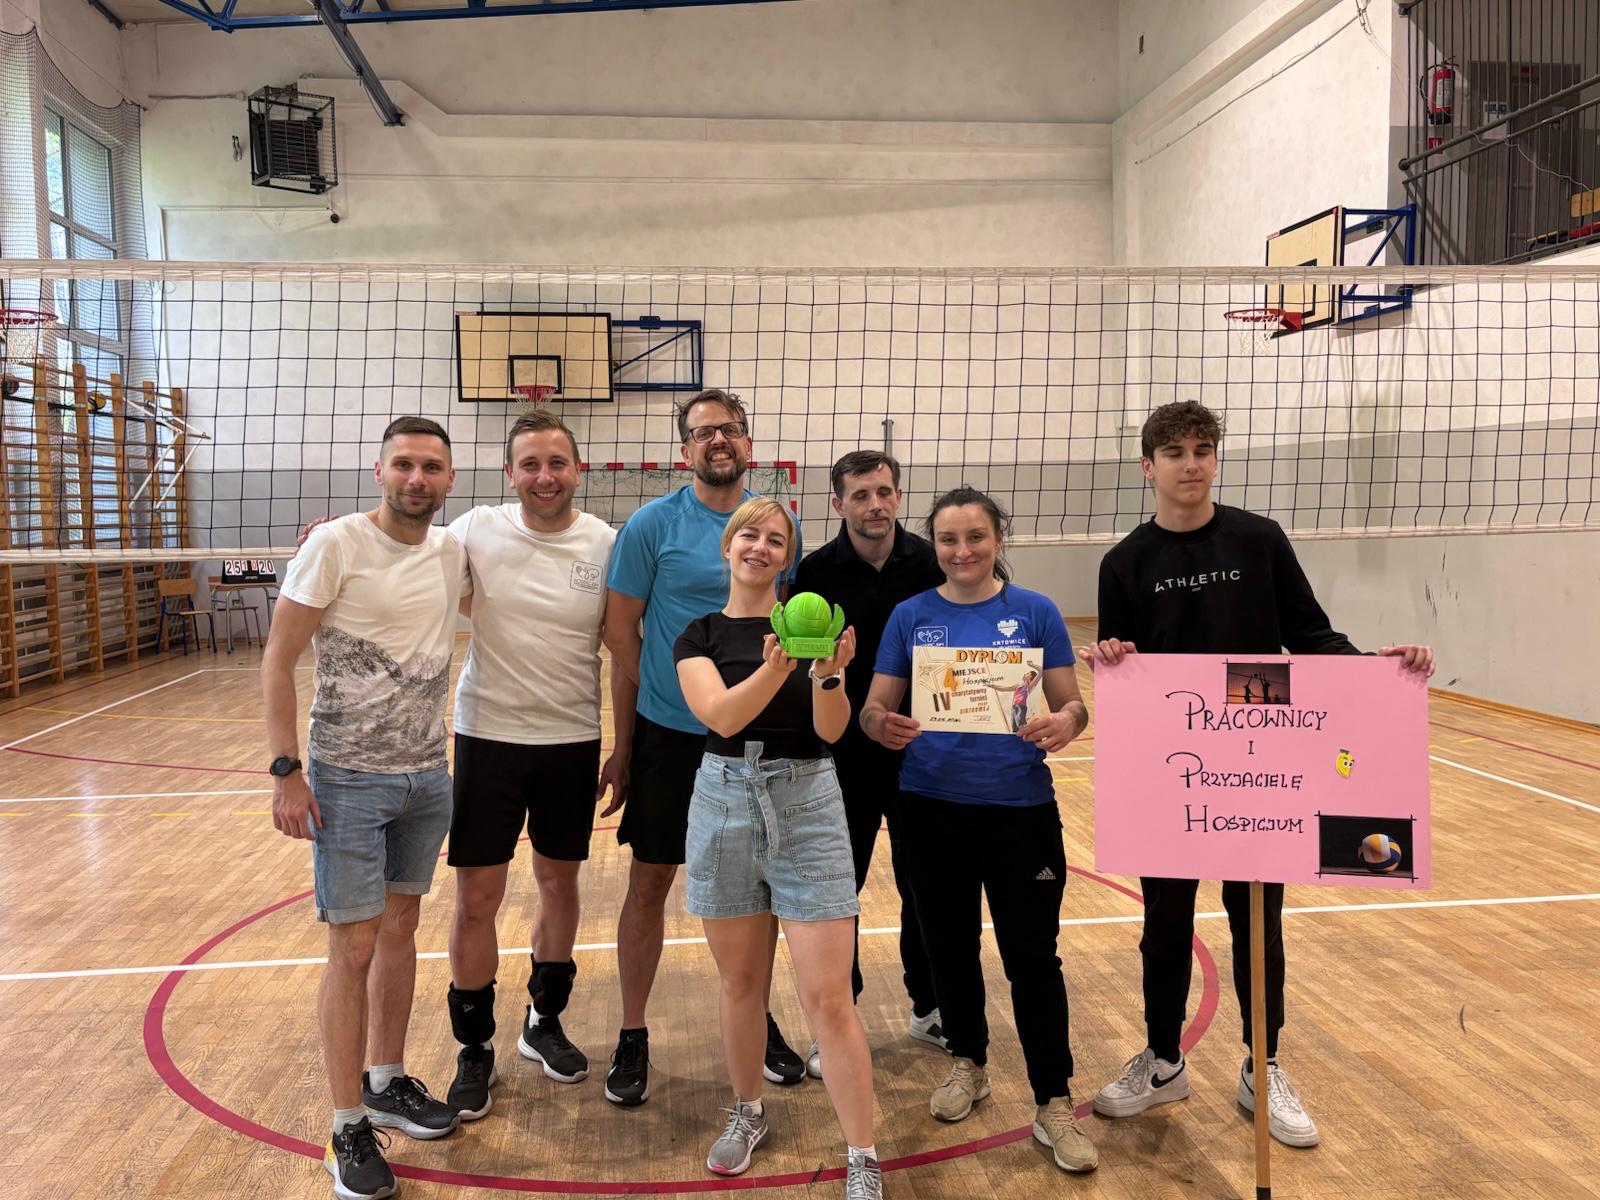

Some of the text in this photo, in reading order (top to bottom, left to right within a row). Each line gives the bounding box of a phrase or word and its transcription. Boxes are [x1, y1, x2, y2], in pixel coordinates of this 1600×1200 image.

[225, 561, 241, 574] 25
[259, 560, 273, 573] 20
[956, 649, 1023, 664] DYPLOM
[943, 667, 958, 691] 4
[952, 667, 986, 677] MIEJSCE
[932, 691, 951, 712] IV
[1165, 690, 1328, 731] PRACOWNICY
[1247, 740, 1255, 755] I
[1184, 804, 1304, 833] HOSPICJUM
